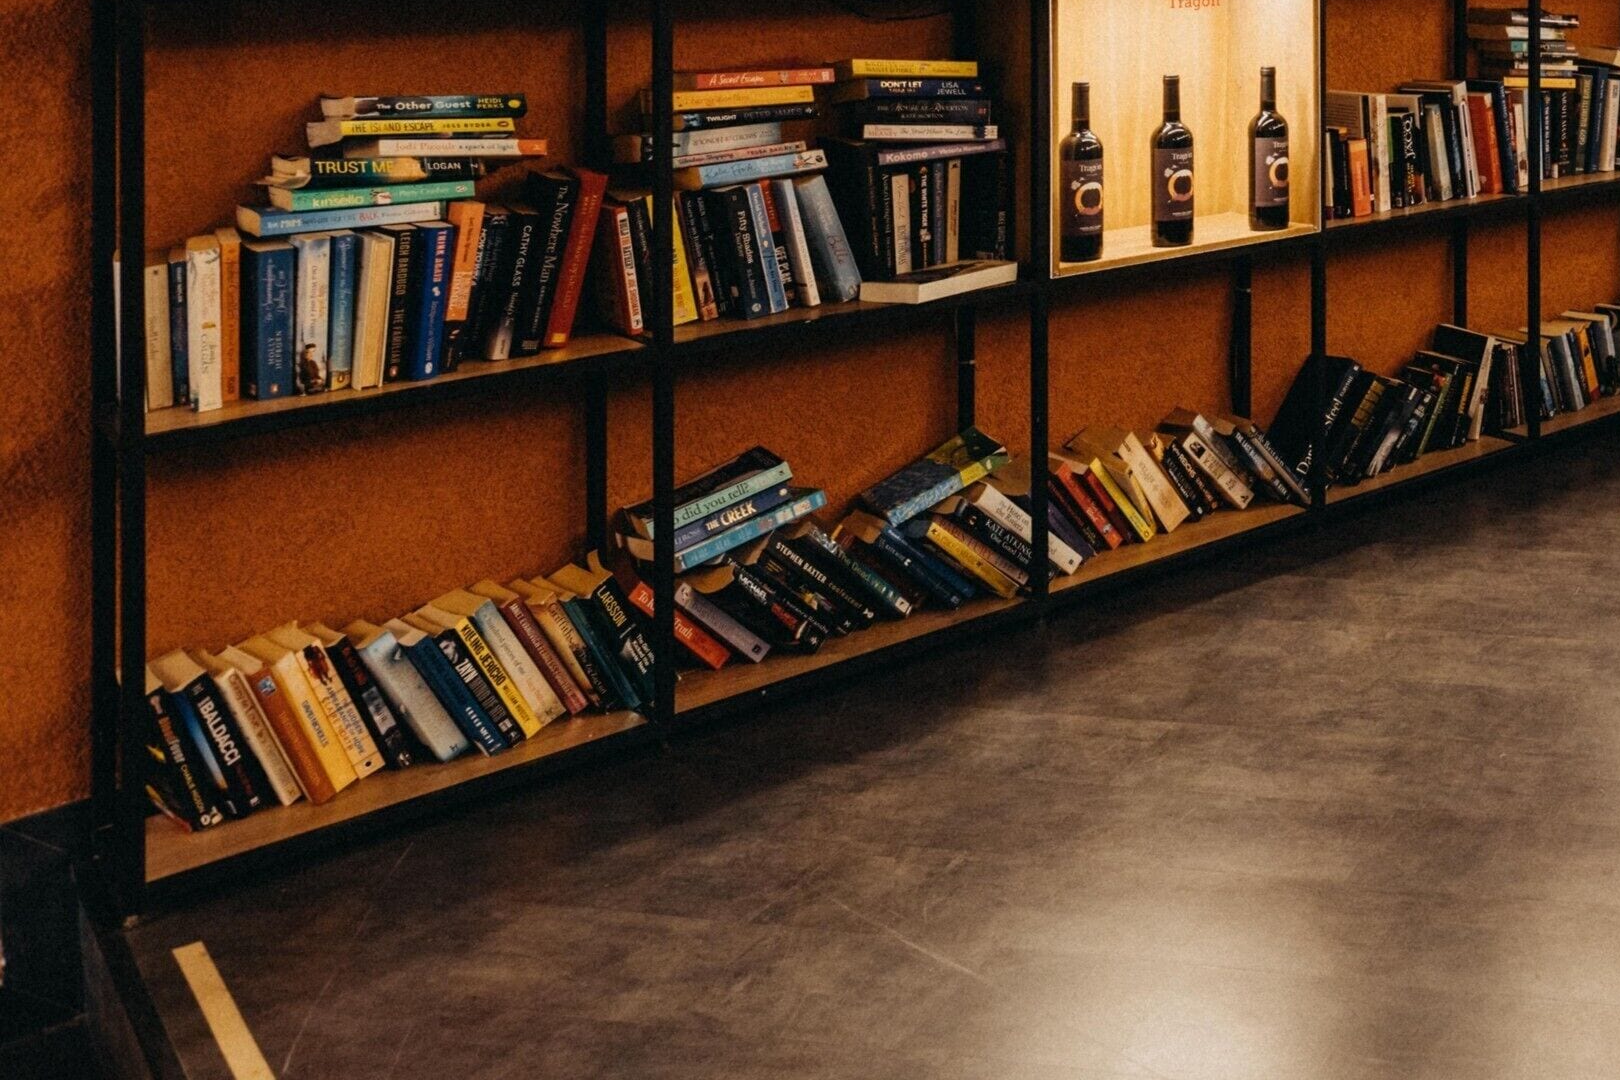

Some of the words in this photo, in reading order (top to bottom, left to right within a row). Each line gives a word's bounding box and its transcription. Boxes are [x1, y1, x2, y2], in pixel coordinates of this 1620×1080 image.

[937, 88, 967, 96] JEWELL
[395, 101, 432, 112] Other
[435, 99, 471, 110] Guest
[706, 114, 738, 122] TWILIGHT
[404, 121, 435, 132] ESCAPE
[315, 161, 369, 174] TRUST
[371, 160, 393, 173] ME
[427, 161, 462, 171] LOGAN
[886, 152, 928, 163] Kokomo
[312, 194, 364, 209] kinsella
[558, 185, 569, 199] The
[546, 201, 569, 255] Nowhere
[738, 211, 749, 232] Fifty
[399, 232, 412, 254] LEIGH
[436, 230, 448, 257] THINK
[520, 224, 533, 255] CATHY
[743, 232, 755, 264] Shades
[395, 257, 409, 296] BARDUGO
[511, 257, 525, 287] GLASS
[540, 255, 558, 283] Man
[395, 308, 405, 324] THE
[391, 325, 403, 364] FAMILIAR
[1178, 451, 1197, 478] REICHS
[682, 505, 703, 522] did
[703, 496, 726, 514] you
[726, 482, 750, 502] tell?
[1006, 504, 1019, 517] Hotel
[704, 520, 720, 531] THE
[719, 500, 758, 526] CREEK
[984, 517, 1004, 537] KATE
[776, 542, 804, 568] STEPHEN
[802, 560, 828, 585] BAXTER
[1001, 541, 1015, 554] Good
[1015, 551, 1031, 565] Turn
[508, 602, 526, 621] JANET
[595, 584, 629, 628] LARSSON
[461, 624, 483, 657] KILLING
[480, 652, 505, 687] JERICHO
[455, 657, 475, 685] ZAYN
[198, 696, 242, 765] BALDACCI
